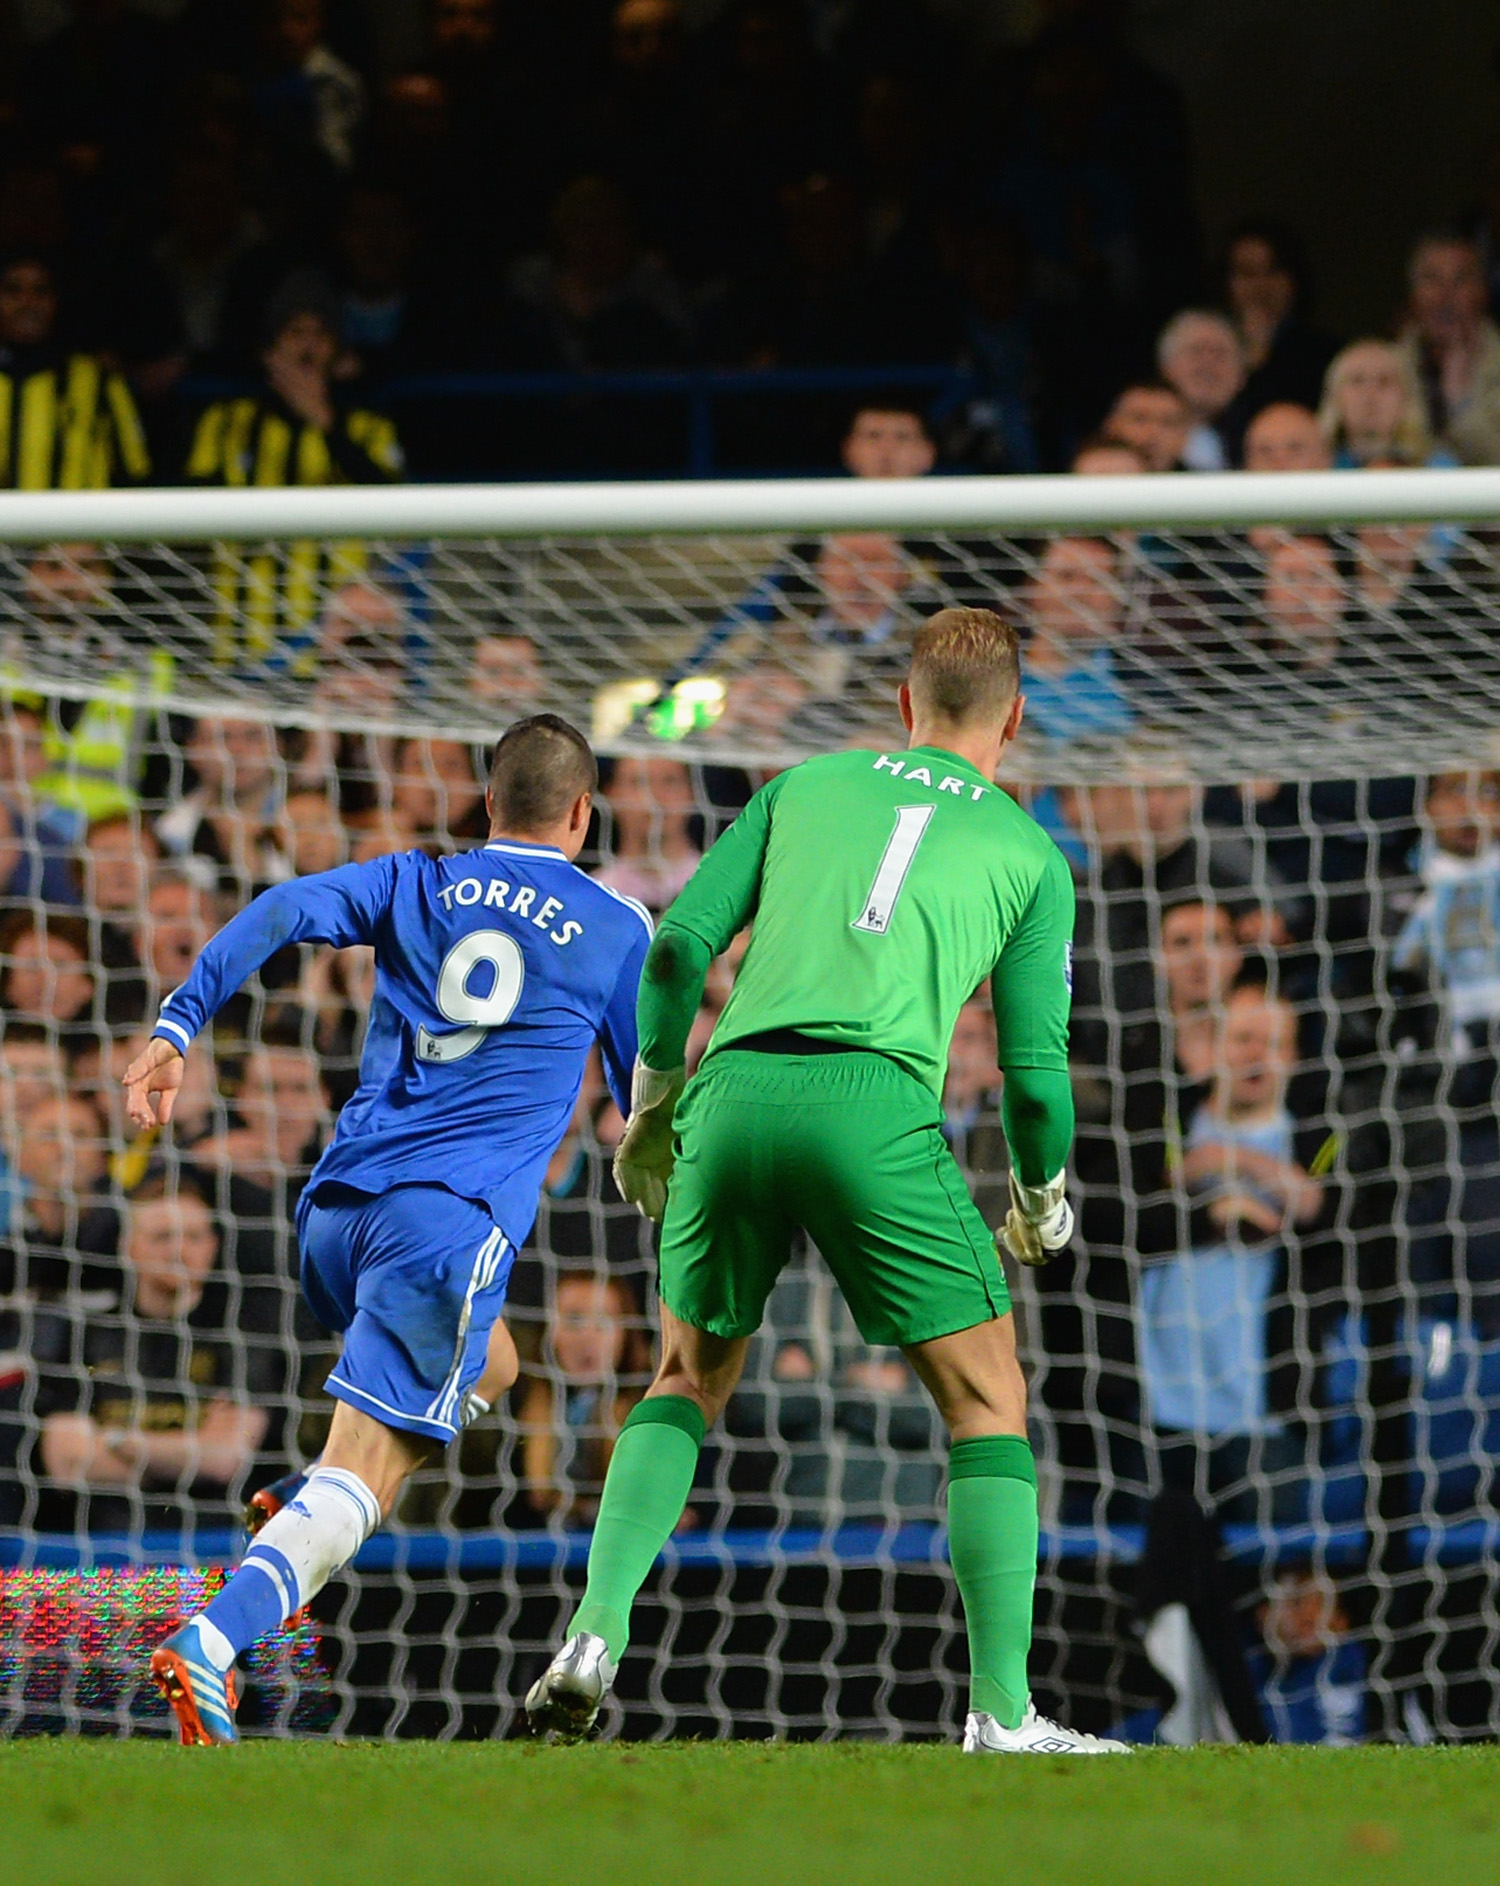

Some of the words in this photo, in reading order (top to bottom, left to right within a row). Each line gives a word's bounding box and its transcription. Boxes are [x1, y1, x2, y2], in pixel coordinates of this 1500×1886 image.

[872, 754, 991, 802] HART
[437, 877, 584, 946] TORRES
[850, 803, 937, 936] 1
[416, 928, 525, 1064] 9
